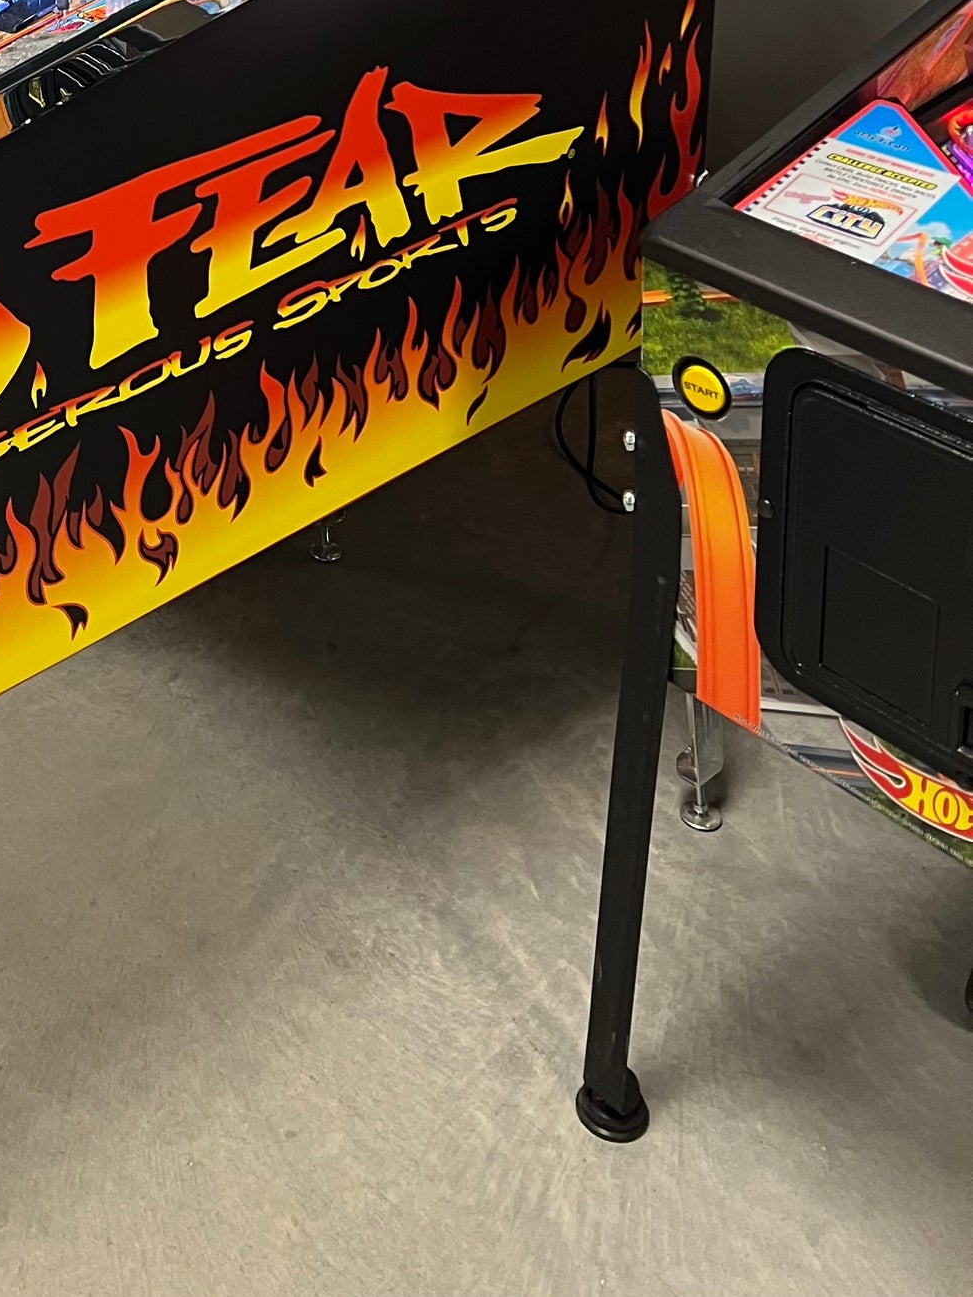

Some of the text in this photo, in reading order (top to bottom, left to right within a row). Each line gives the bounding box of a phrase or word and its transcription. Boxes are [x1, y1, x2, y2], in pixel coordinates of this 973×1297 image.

[826, 152, 937, 191] CHALLENGE ACCEPTED
[27, 65, 585, 370] FEAR
[274, 198, 518, 332] SPORTS
[683, 381, 720, 400] START
